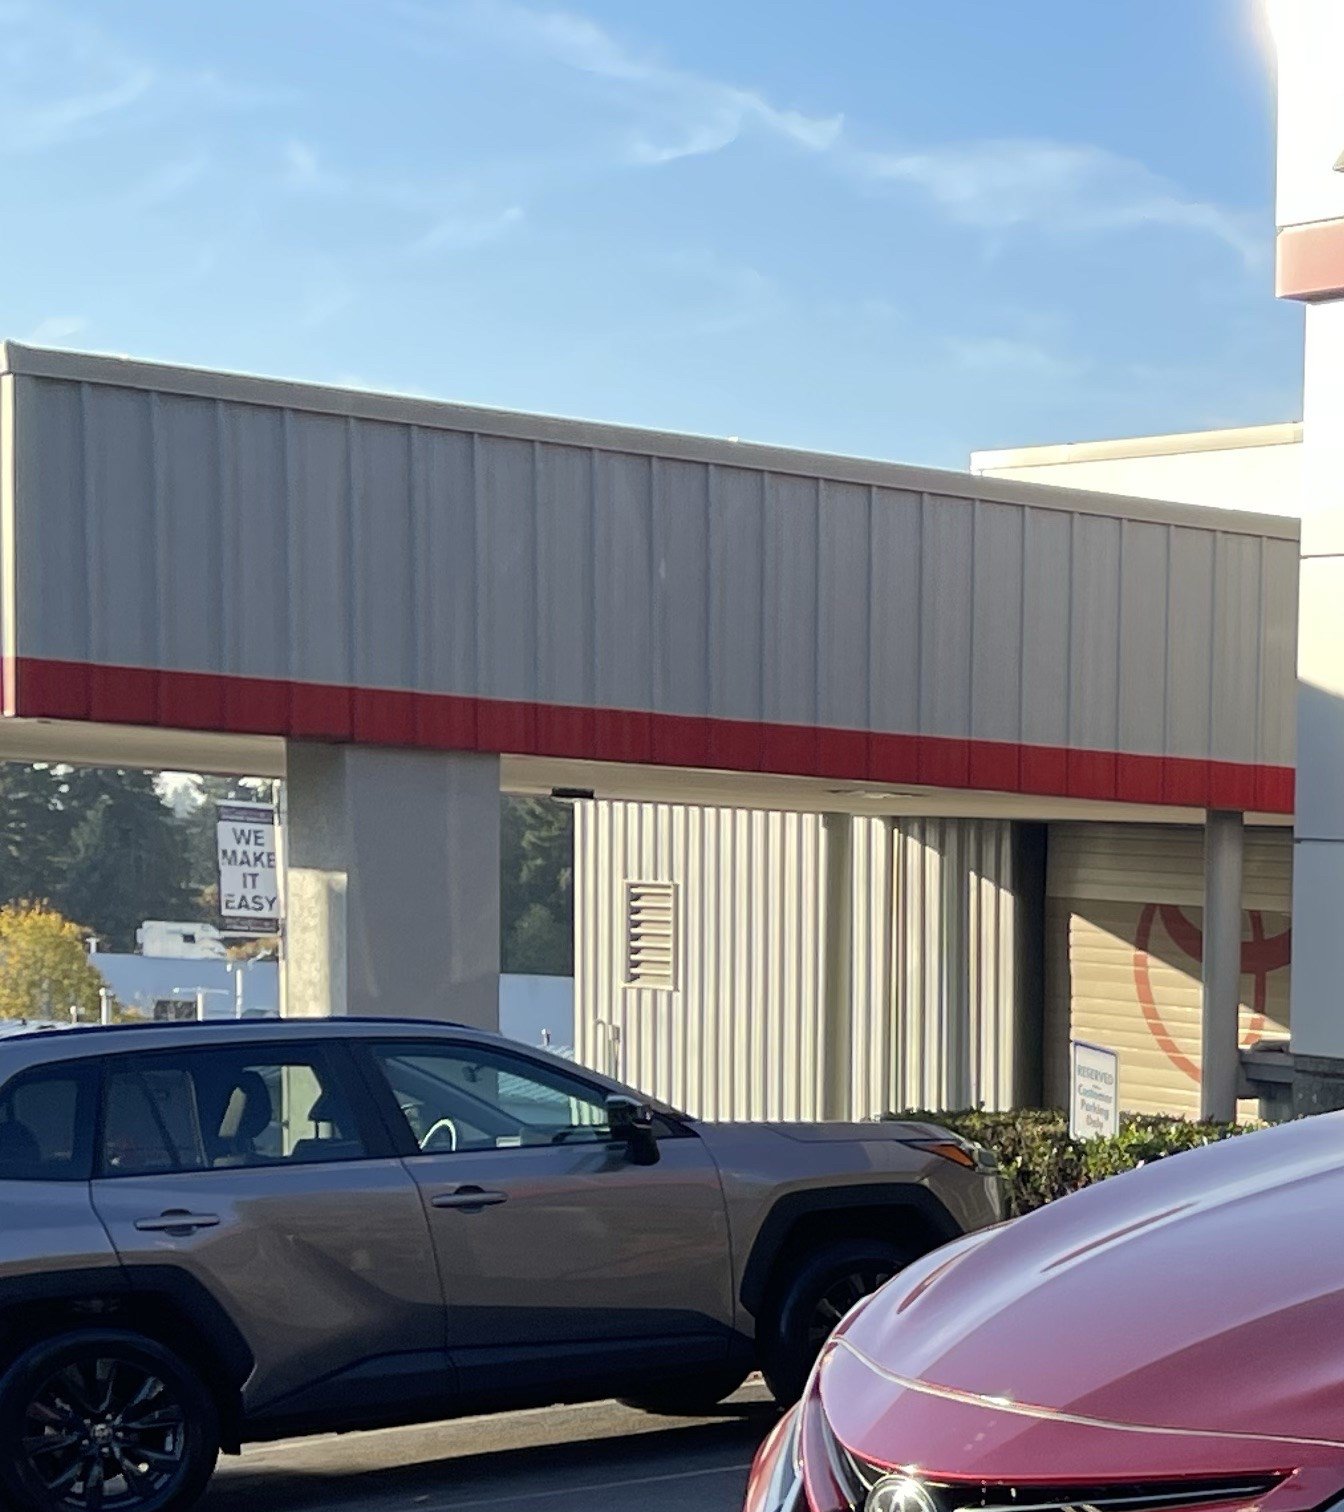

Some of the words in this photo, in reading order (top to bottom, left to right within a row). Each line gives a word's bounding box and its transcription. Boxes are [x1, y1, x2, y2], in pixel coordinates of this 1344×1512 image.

[231, 826, 265, 847] WE
[221, 848, 276, 869] MAKE
[242, 872, 260, 890] IT
[225, 893, 277, 912] EASY
[1077, 1064, 1114, 1086] RESERVED
